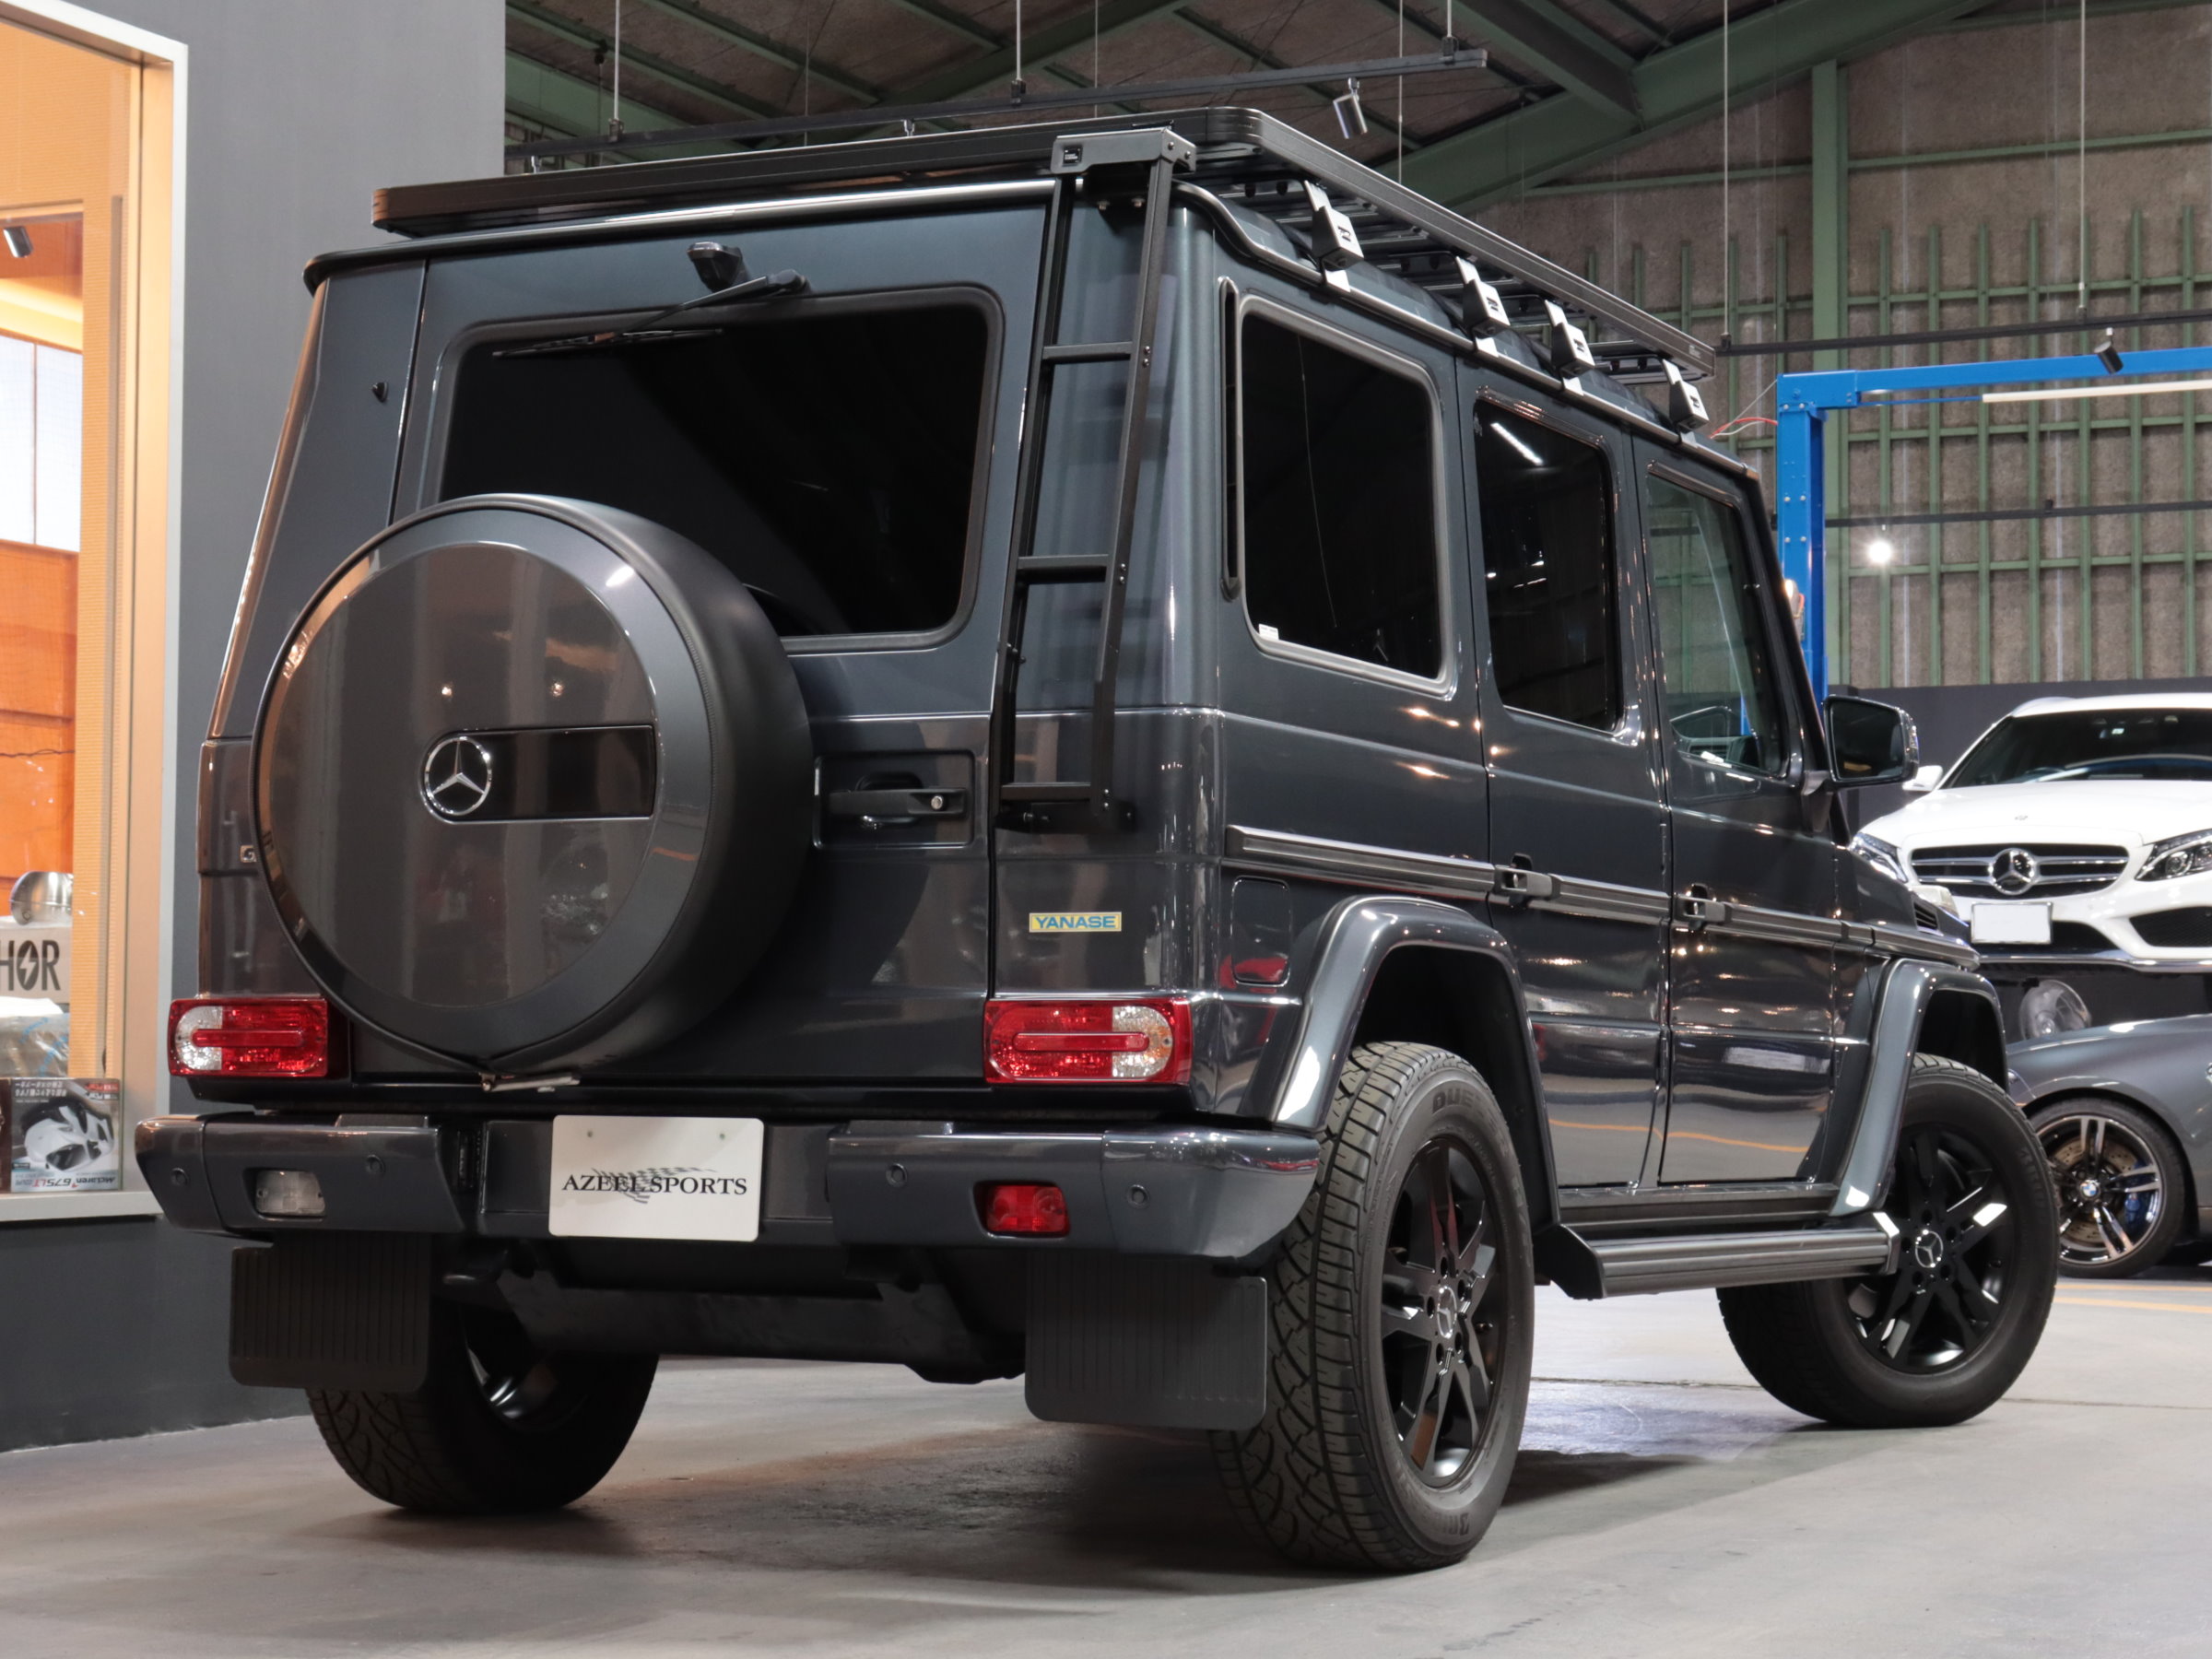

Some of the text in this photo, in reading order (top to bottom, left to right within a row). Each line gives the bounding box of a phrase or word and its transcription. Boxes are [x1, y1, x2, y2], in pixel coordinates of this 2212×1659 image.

[1035, 915, 1116, 928] YANASE
[32, 1178, 72, 1188] 675LT
[76, 1176, 116, 1184] McLaren
[562, 1174, 747, 1195] AZEEL SPORTS
